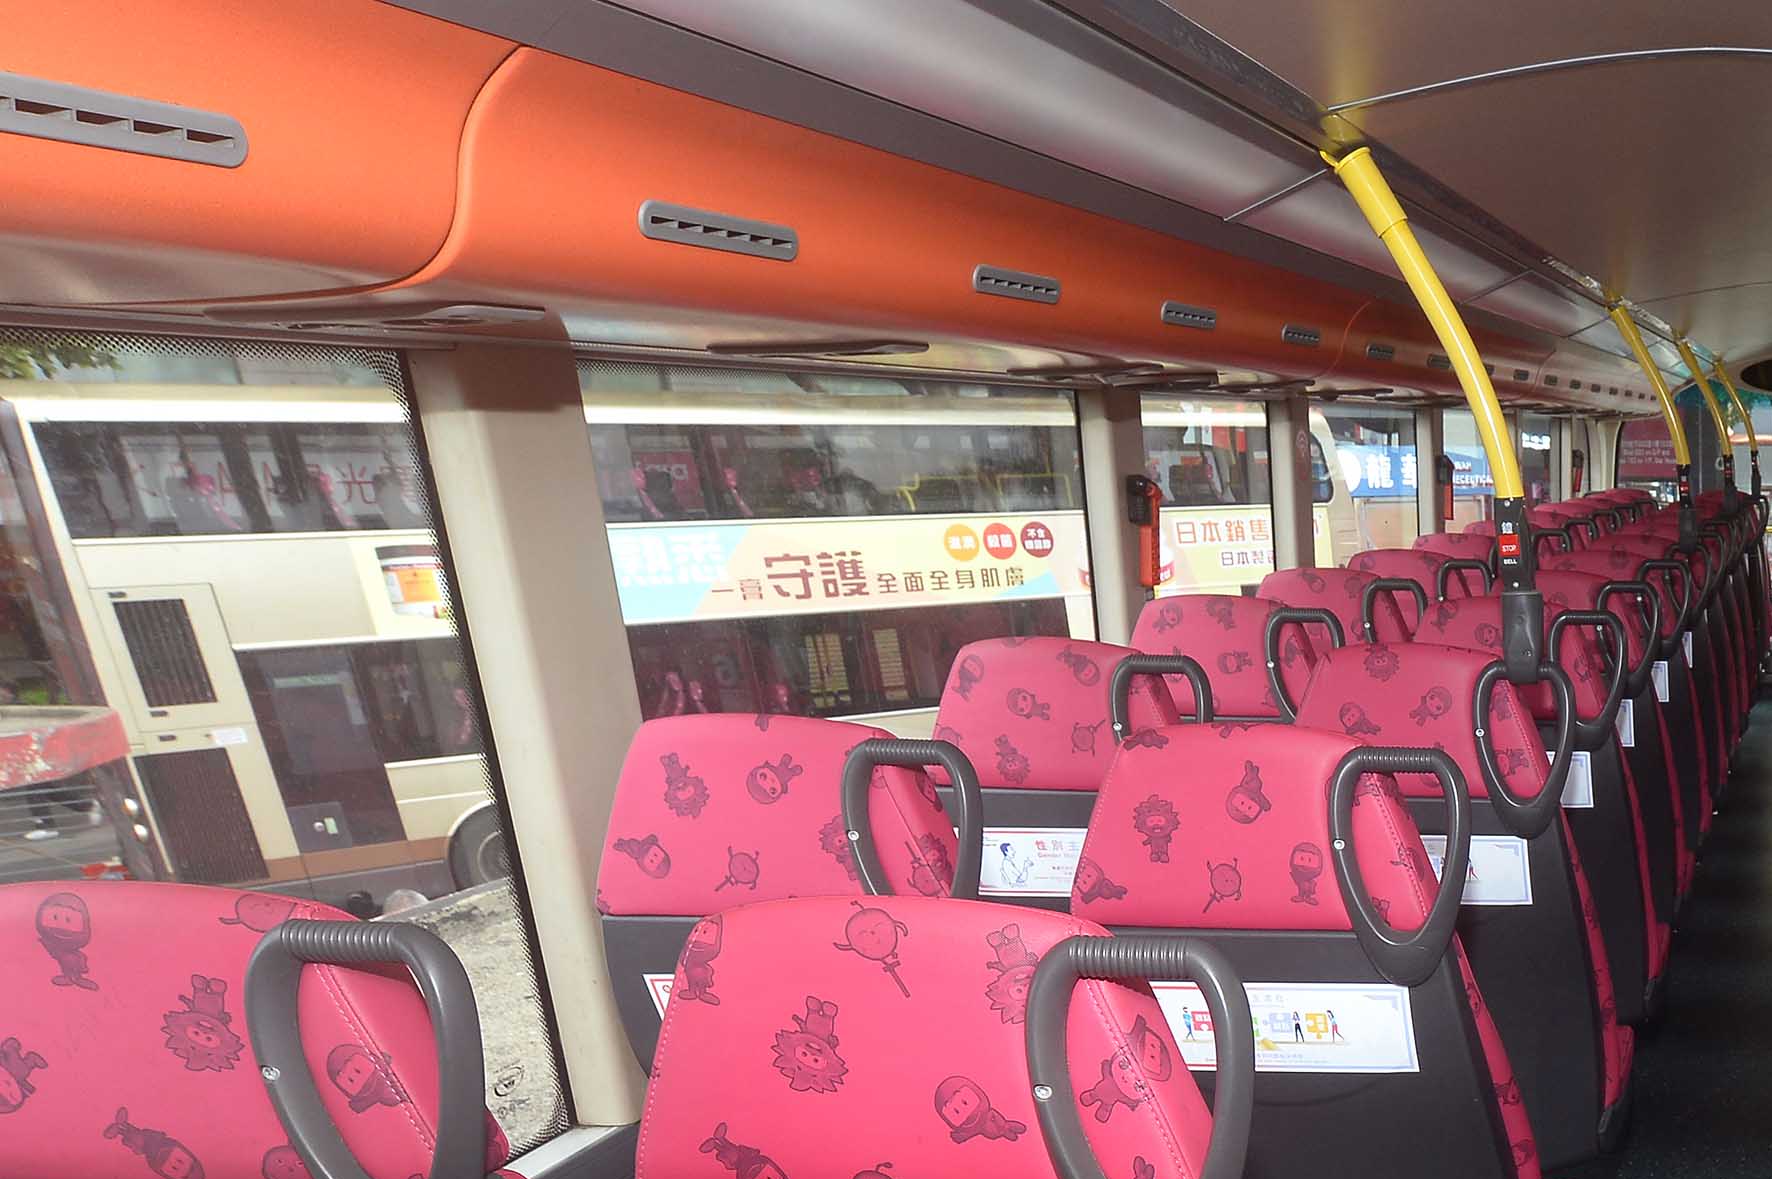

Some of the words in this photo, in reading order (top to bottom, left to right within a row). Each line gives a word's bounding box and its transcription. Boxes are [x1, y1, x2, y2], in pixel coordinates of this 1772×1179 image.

[764, 551, 870, 600] 守護
[877, 565, 1026, 594] 全面全身肌膚
